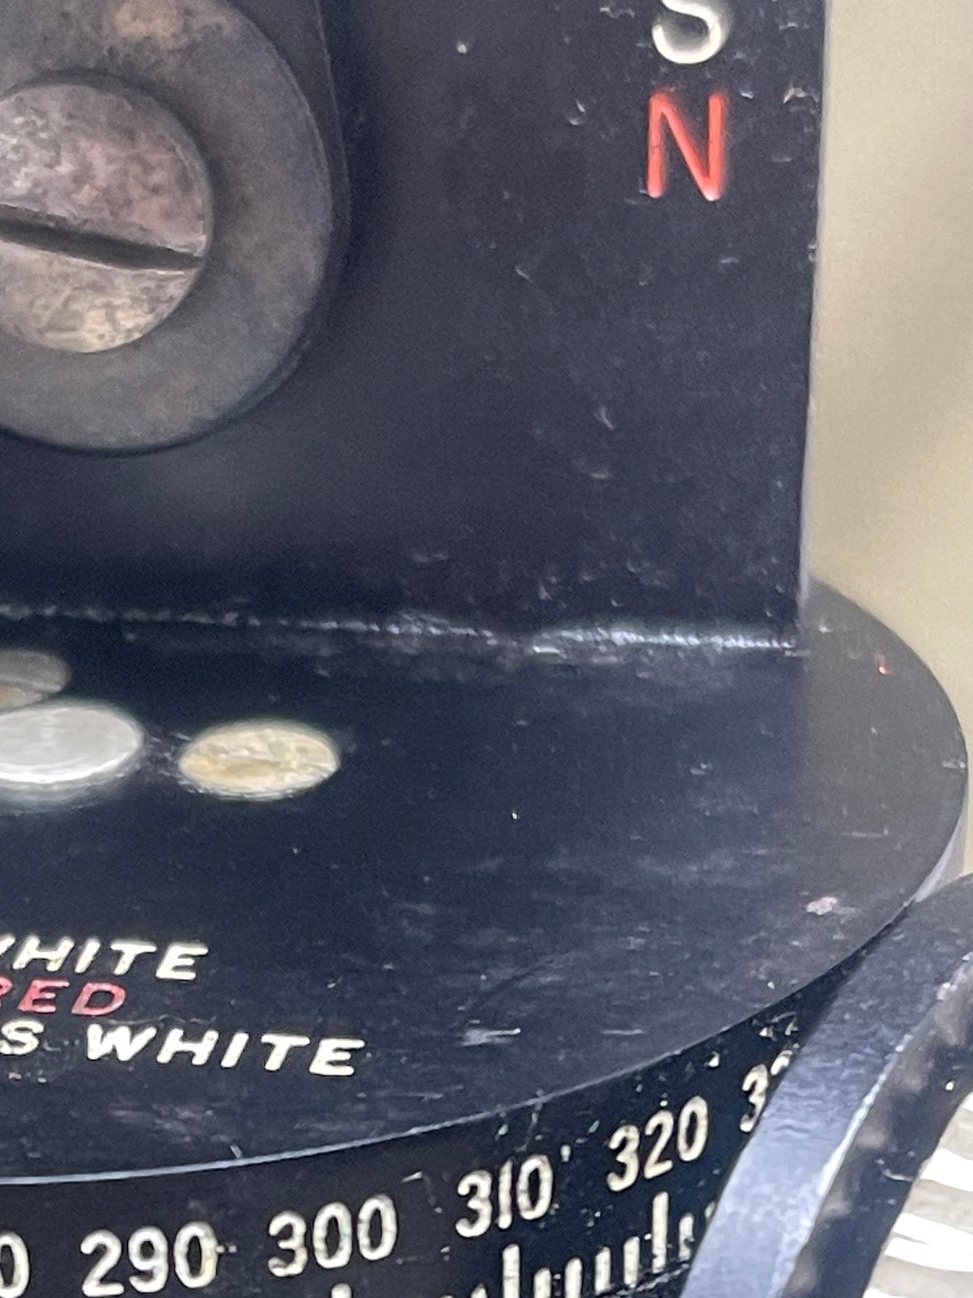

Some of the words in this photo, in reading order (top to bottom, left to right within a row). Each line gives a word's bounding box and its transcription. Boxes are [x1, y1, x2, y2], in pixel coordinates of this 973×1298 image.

[646, 92, 726, 201] N
[84, 1023, 366, 1076] WHITE
[80, 1219, 220, 1298] 290
[267, 1193, 397, 1278] 300
[455, 1154, 554, 1238] 310
[607, 1095, 710, 1193] 320
